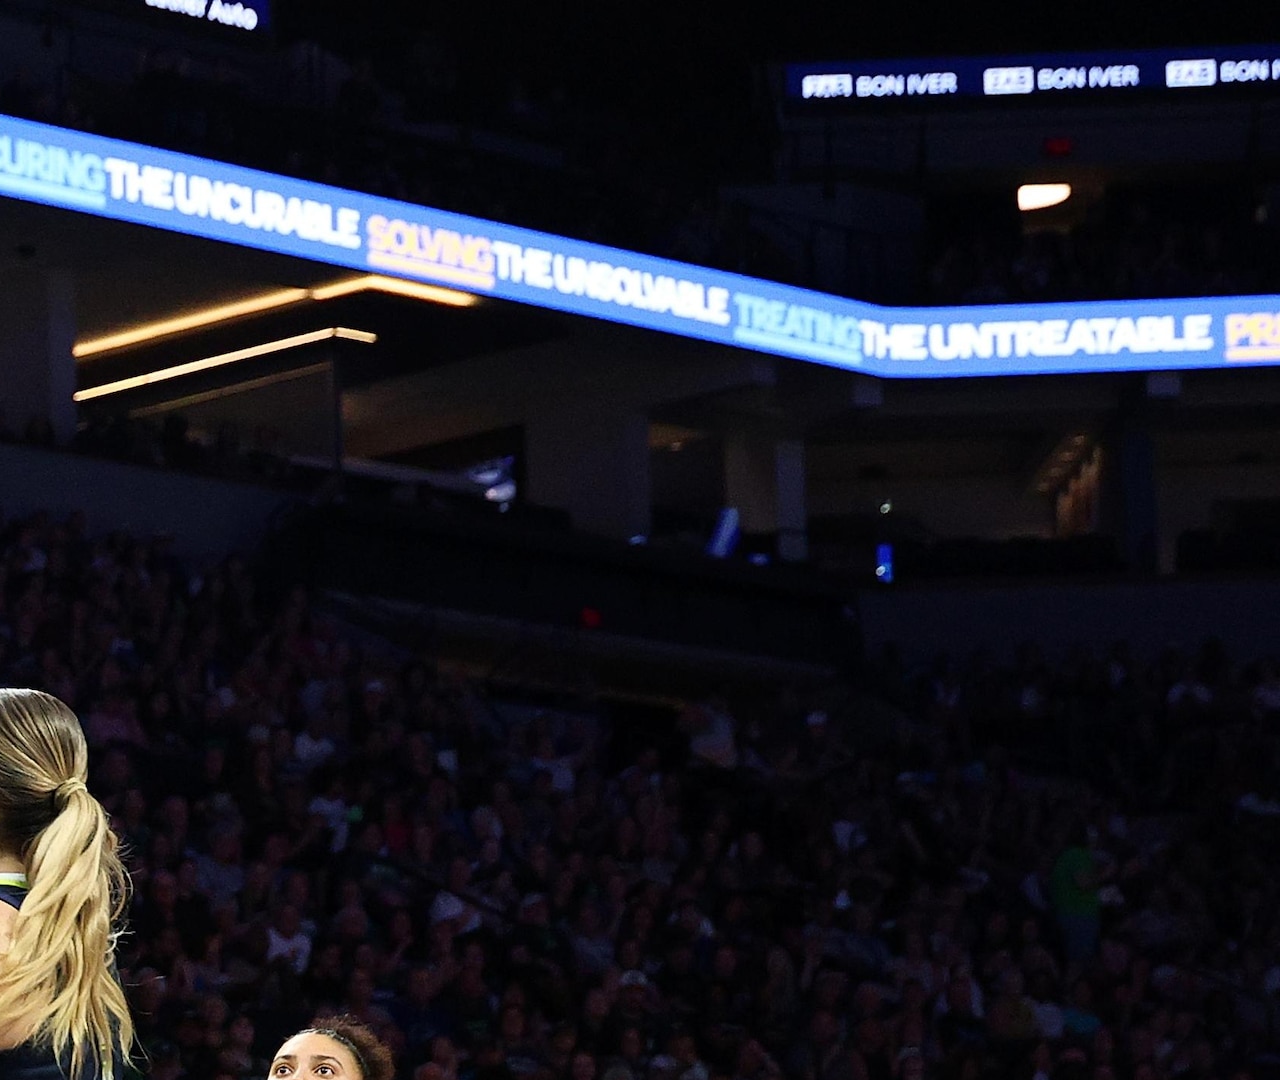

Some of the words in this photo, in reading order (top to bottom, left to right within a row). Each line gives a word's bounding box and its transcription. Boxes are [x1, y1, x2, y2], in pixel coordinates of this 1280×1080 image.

[1037, 67, 1086, 90] BON
[1089, 65, 1139, 88] IVER
[1220, 59, 1270, 82] BON
[856, 75, 904, 97] BON
[907, 72, 957, 95] IVER
[104, 158, 173, 209] THE
[173, 173, 361, 249] UNCURABLE
[367, 214, 494, 273] SOLVING
[491, 241, 552, 289] THE
[553, 254, 731, 326] UNSOLVABLE
[734, 292, 861, 351] TREATING
[859, 319, 928, 361] THE
[929, 314, 1214, 360] UNTREATABLE
